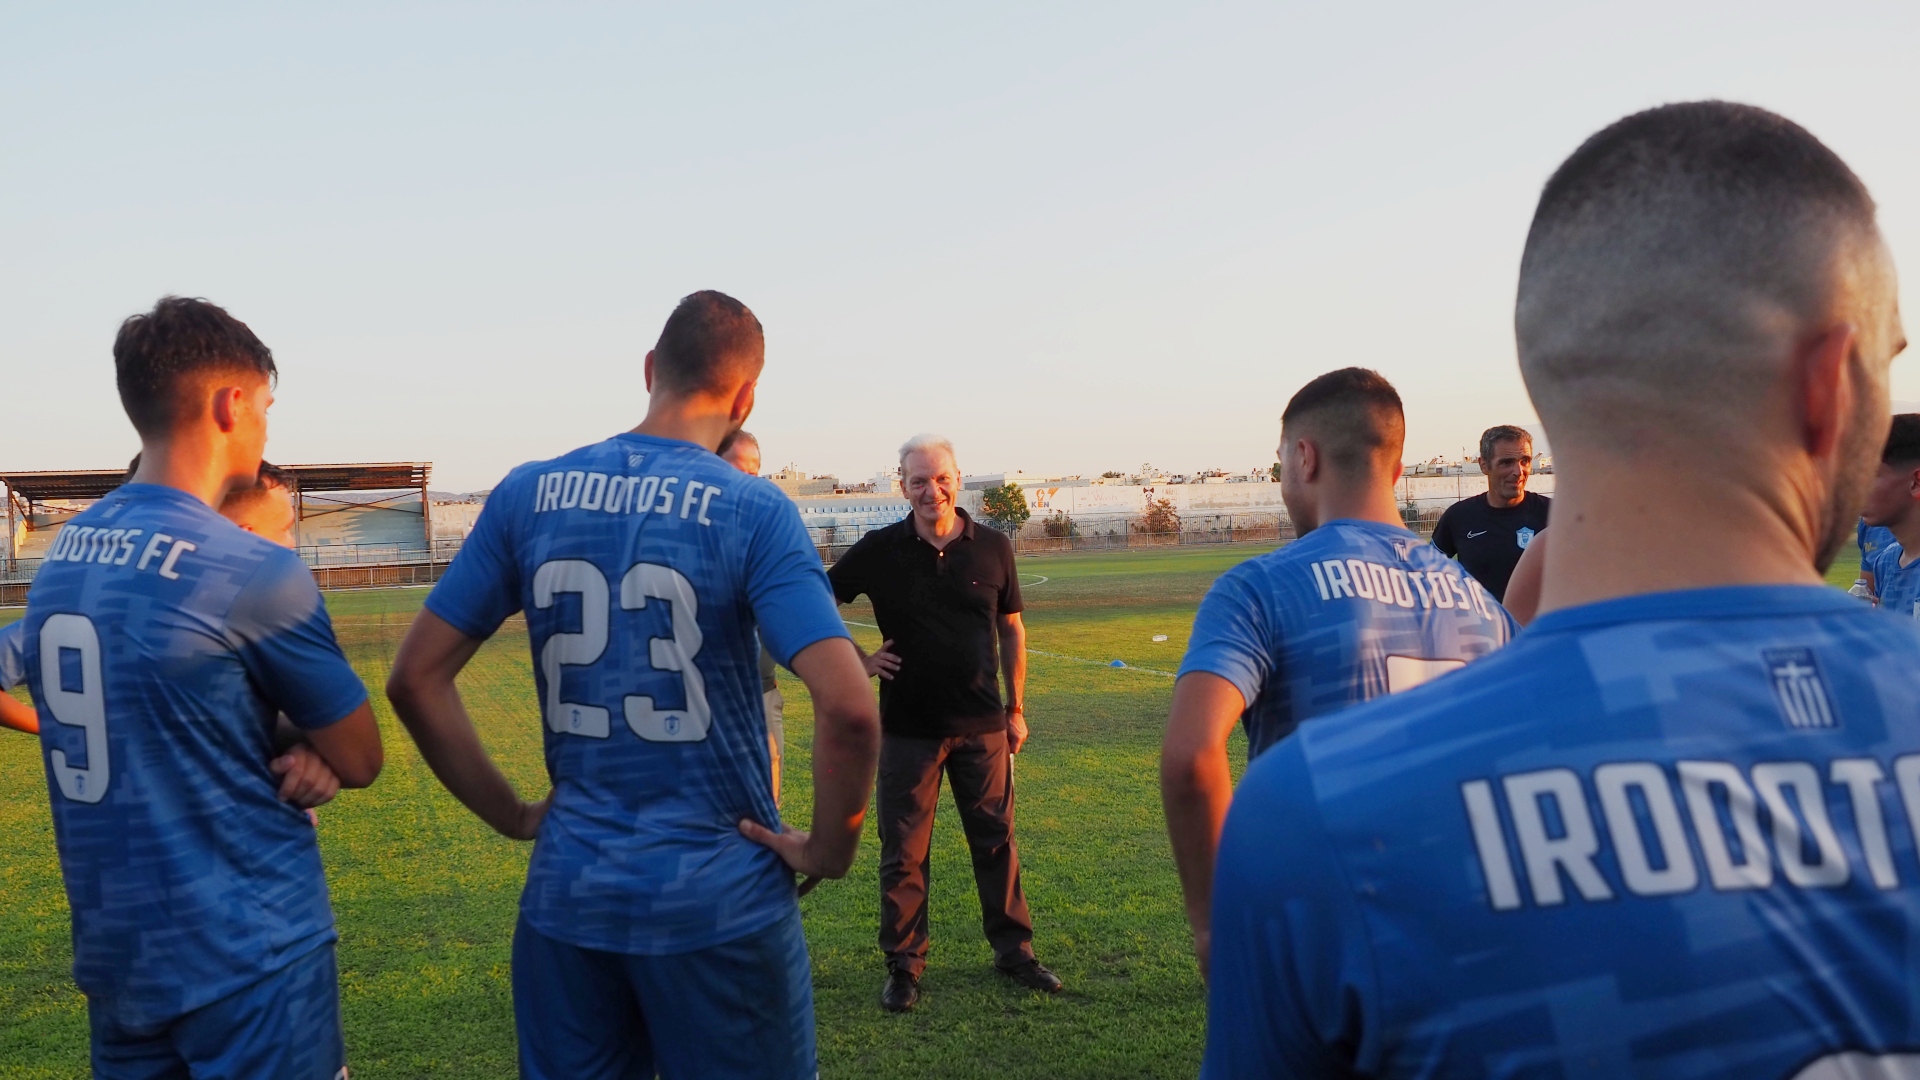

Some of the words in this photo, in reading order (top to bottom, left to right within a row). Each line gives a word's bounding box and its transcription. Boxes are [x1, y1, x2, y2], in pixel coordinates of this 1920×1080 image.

[534, 470, 680, 515] IRODOTOS
[679, 479, 722, 527] FC
[1031, 501, 1050, 509] KEN
[135, 532, 197, 581] FC
[1310, 559, 1471, 611] IRODOTOS
[532, 558, 712, 743] 23
[38, 613, 110, 804] 9
